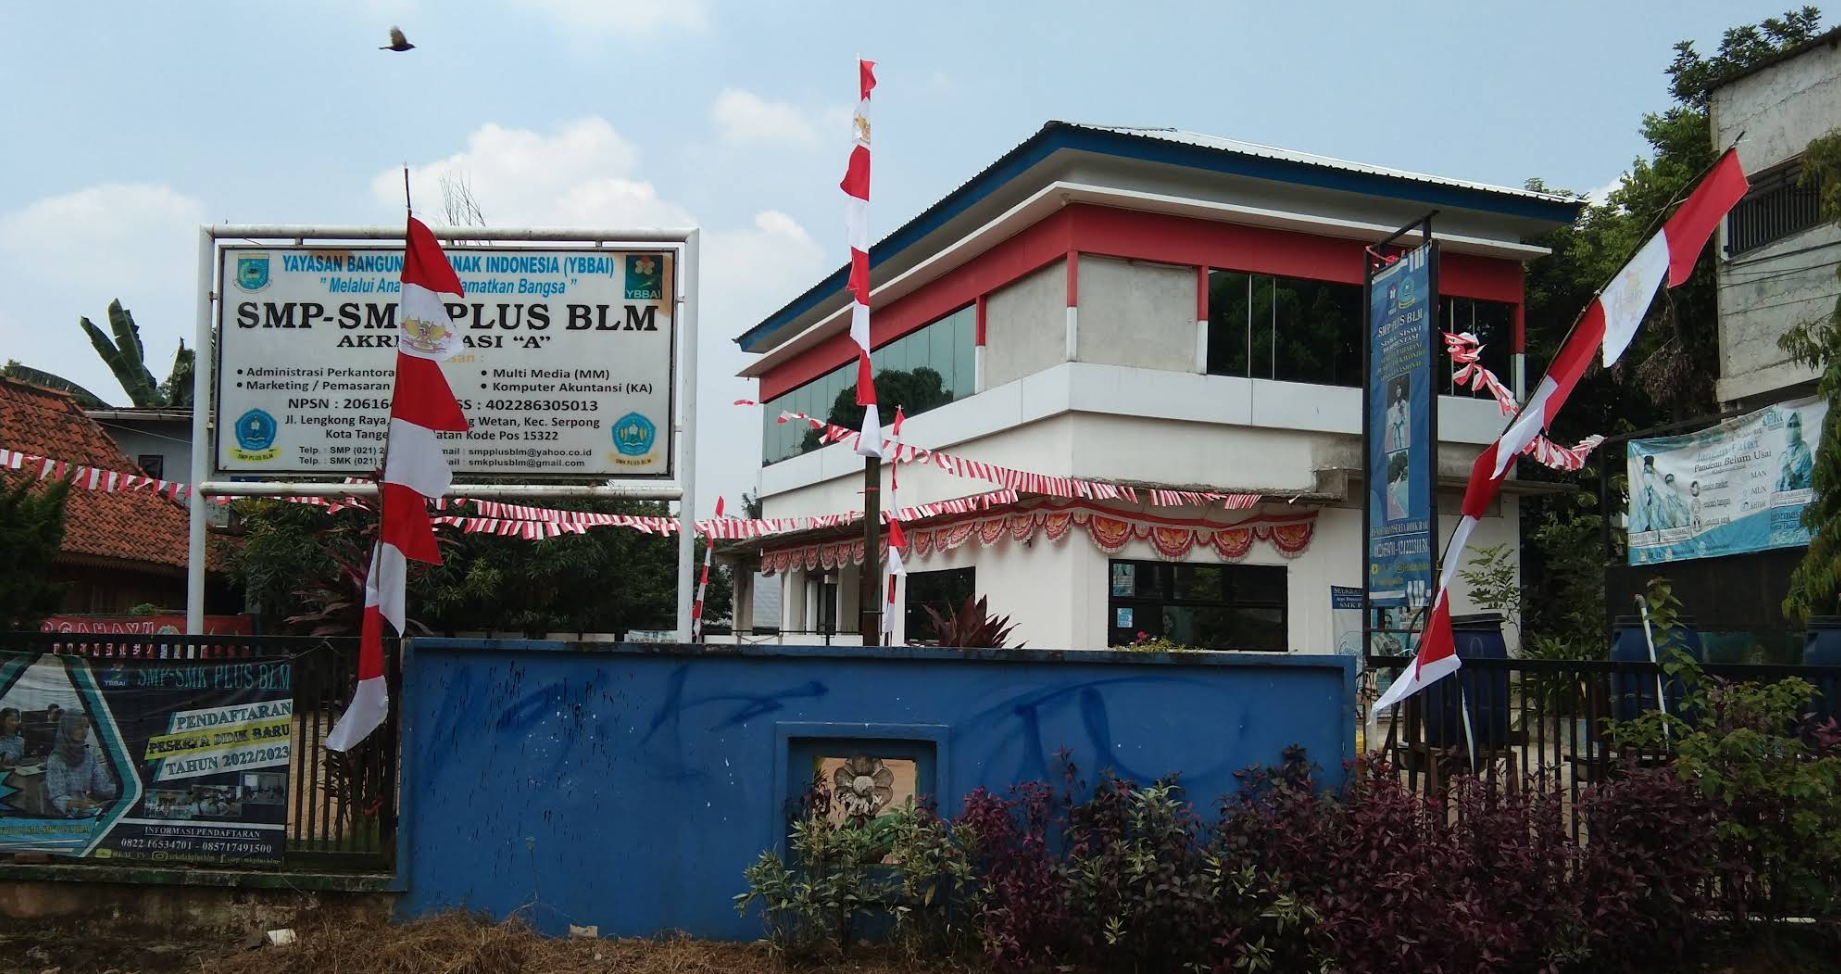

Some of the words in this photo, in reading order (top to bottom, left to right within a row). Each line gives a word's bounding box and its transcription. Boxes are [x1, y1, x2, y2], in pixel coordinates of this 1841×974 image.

[283, 255, 343, 273] YAYASAN
[347, 255, 404, 273] BANGUN
[485, 256, 560, 274] INDONESIA
[563, 256, 615, 278] (YBBAI)
[328, 277, 378, 294] Melalui
[379, 277, 401, 294] Ana
[459, 277, 514, 295] amatkan
[517, 278, 566, 298] Bangsa
[626, 289, 661, 299] YBBAI
[236, 301, 399, 330] SMP-SM
[444, 302, 550, 331] PLUS
[565, 304, 659, 331] BLM
[246, 367, 324, 378] Administrasi
[327, 367, 396, 378] Perkantora
[493, 368, 527, 379] Multi
[530, 368, 571, 379] Media
[574, 368, 611, 381] (MM)
[246, 380, 309, 393] Marketing
[322, 381, 391, 391] Pemasaran
[493, 382, 555, 394] Komputer
[559, 382, 623, 393] Akuntansi
[626, 383, 653, 395] (KA)
[288, 398, 330, 410] NPSN
[343, 398, 393, 410] 20616
[456, 399, 473, 411] SS
[485, 399, 599, 412] 402286305013
[285, 415, 297, 426] Jl.
[300, 415, 356, 428] Lengkong
[478, 417, 521, 429] Wetan,
[524, 417, 548, 428] Kec.
[551, 417, 601, 430] Serpong
[325, 429, 352, 439] Kota
[355, 429, 389, 441] Tange
[466, 430, 496, 441] Kode
[499, 430, 520, 441] Pos
[523, 431, 559, 441] 15322
[329, 446, 351, 454] SMP
[353, 446, 377, 456] (021)
[468, 447, 592, 458] smpplusblm@yahoo.co.id
[329, 457, 351, 465] SMK
[353, 457, 377, 466] (021)
[468, 458, 586, 468] smkplusblm@gmail.com
[1724, 453, 1751, 466] Belum
[137, 664, 207, 689] SMP-SMK
[214, 663, 252, 690] PLUS
[259, 663, 290, 690] BLM
[176, 701, 292, 730] PENDAFTARAN
[149, 735, 211, 755] PESERTA
[214, 729, 248, 746] DIDIK
[252, 723, 290, 738] BARU
[165, 755, 219, 776] TAHUN
[222, 745, 290, 768] 2022/2023
[144, 826, 195, 836] INFORMASI
[196, 827, 260, 839] PENDAFTARAN
[121, 837, 144, 849] 0822
[147, 839, 192, 851] 16534701
[202, 841, 273, 854] 085717491500
